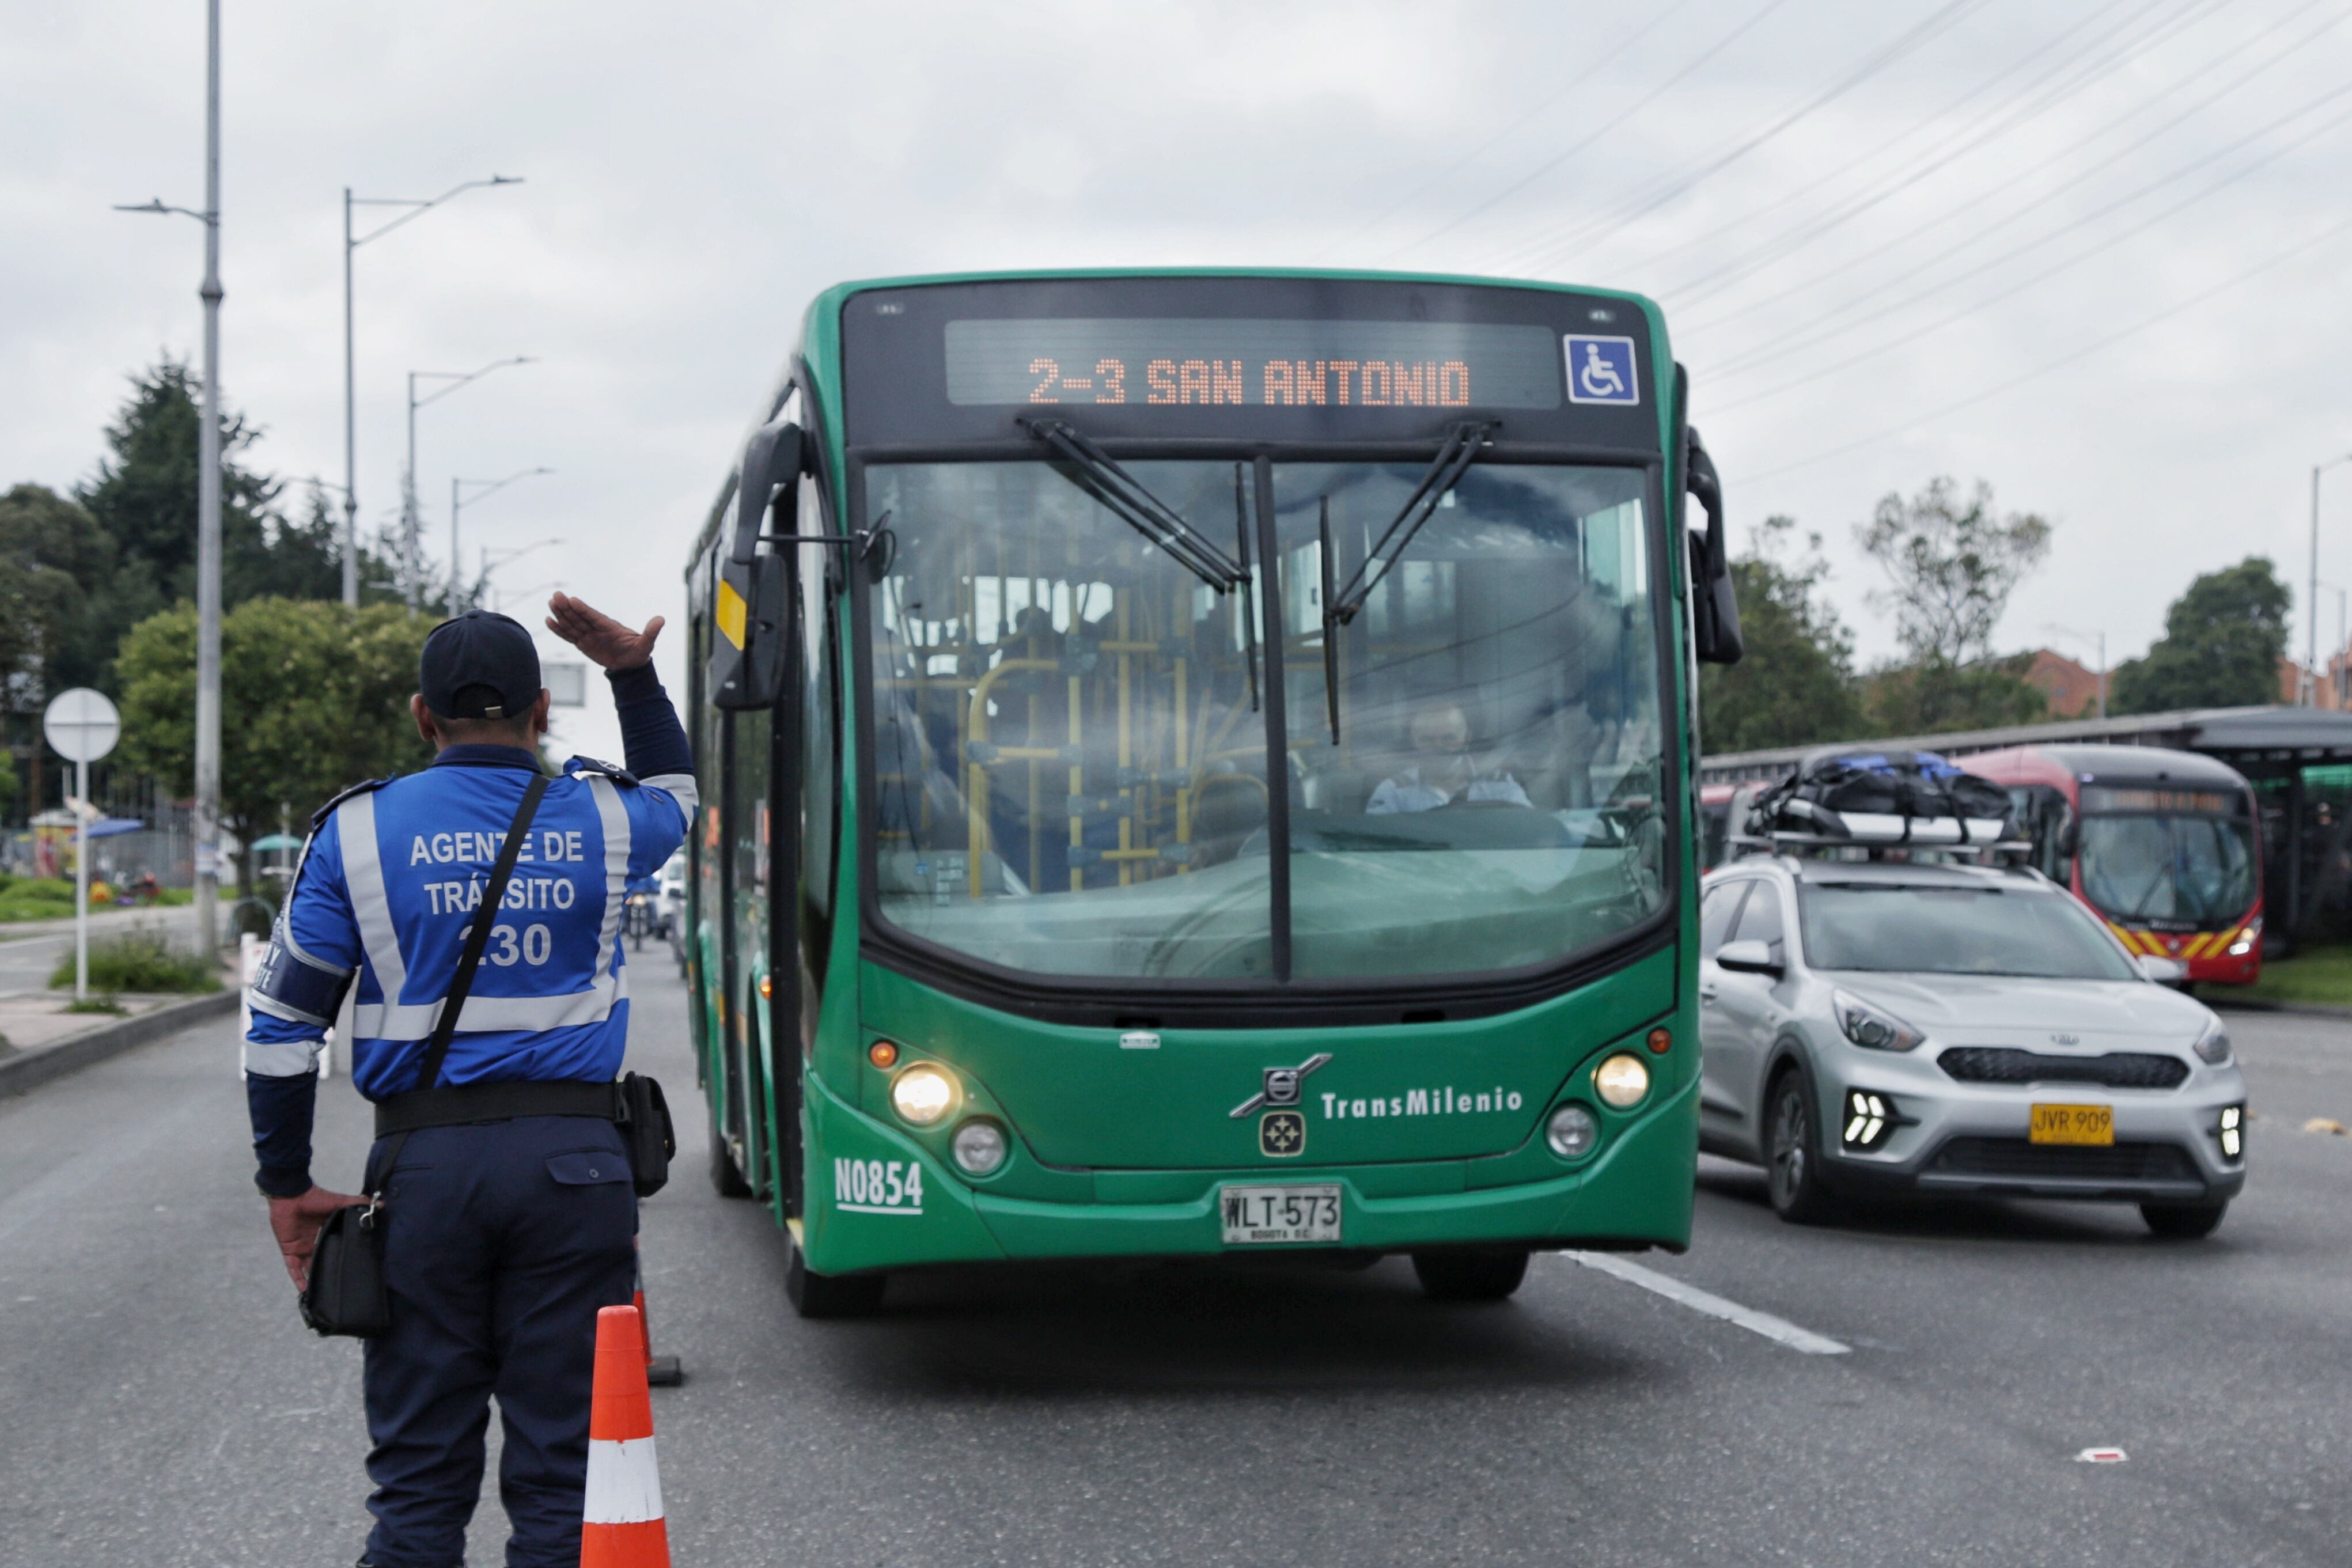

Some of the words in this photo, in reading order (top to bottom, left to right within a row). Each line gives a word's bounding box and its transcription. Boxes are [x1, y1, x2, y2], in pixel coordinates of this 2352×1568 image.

[1029, 358, 1125, 404] 2-3
[1147, 359, 1242, 405] SAN
[1264, 361, 1469, 406] ANTONIO
[544, 831, 584, 862] DE
[423, 872, 575, 915] TRÁSITO
[1320, 1085, 1523, 1119] TransMilenio
[2036, 1109, 2070, 1132] JVR
[2077, 1111, 2111, 1134] 909
[835, 1157, 924, 1206] N0854
